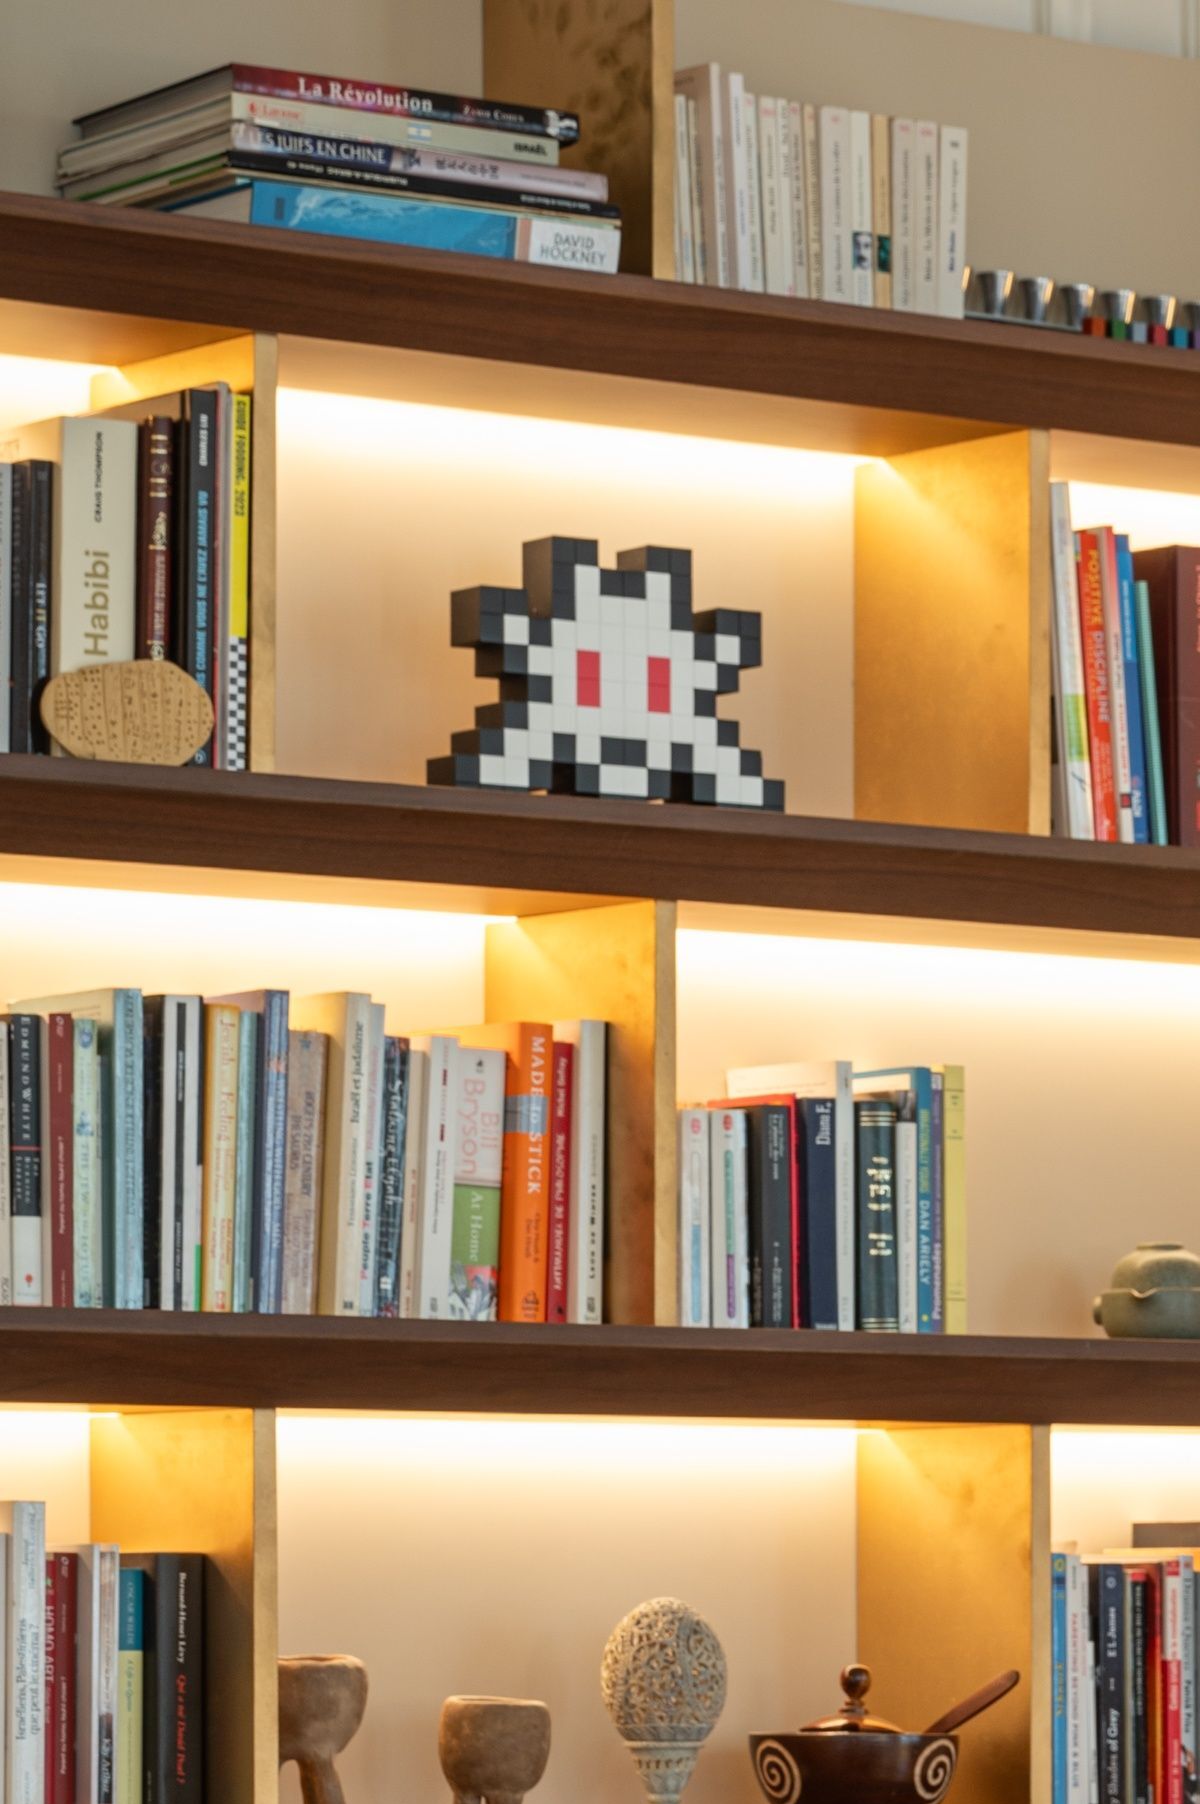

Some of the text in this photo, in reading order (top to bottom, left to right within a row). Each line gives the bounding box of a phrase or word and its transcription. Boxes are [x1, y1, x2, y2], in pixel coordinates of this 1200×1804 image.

[298, 77, 325, 96] La
[329, 81, 434, 114] Révolution
[316, 139, 339, 159] EN
[339, 141, 387, 165] CHINE
[540, 241, 608, 267] HOCKNEY
[554, 231, 596, 250] DAVID
[236, 399, 248, 432] GUIDE
[94, 431, 104, 524] CRAIG THOMPSON
[83, 549, 110, 657] Habibi
[1087, 549, 1110, 722] POSITIVE DISCIPLINE
[219, 1018, 236, 1066] Jewish
[20, 1016, 33, 1142] EDMUND WHITE
[349, 1021, 364, 1124] Israël et judaïsme
[216, 1090, 235, 1142] Feeling
[304, 1091, 316, 1130] ROGET'S
[457, 1078, 486, 1175] Bryson
[481, 1112, 500, 1148] Bill
[527, 1036, 546, 1195] MADE to STICK
[289, 1114, 302, 1170] THESAURUS
[380, 1079, 404, 1206] Stalking Elijah
[301, 1153, 313, 1197] CENTURY
[553, 1133, 566, 1202] PHILOSOPHIE
[271, 1223, 282, 1248] MEN
[361, 1193, 372, 1230] Terre
[468, 1191, 484, 1262] At Home
[553, 1203, 565, 1220] DE
[359, 1232, 371, 1281] Peuple
[919, 1199, 930, 1285] DAN ARIELY
[931, 1242, 942, 1321] Promenades
[45, 1605, 55, 1654] HOMO
[125, 1581, 135, 1646] OSCAR WILDE
[175, 1572, 187, 1664] Bernard-Henri Lévy
[1106, 1606, 1117, 1641] James
[1071, 1612, 1080, 1673] PARENTING
[16, 1618, 28, 1741] Israéliens, Palestiniens
[28, 1623, 41, 1736] que peut le cinéma ?
[45, 1657, 55, 1682] ART
[1071, 1676, 1080, 1720] BEYOND
[1106, 1707, 1120, 1738] Grey
[1183, 1679, 1192, 1733] Patrick Price
[1071, 1723, 1080, 1748] PINK
[1106, 1739, 1120, 1752] of
[100, 1737, 112, 1793] Kay Arthur
[1071, 1760, 1080, 1788] BLUE
[1106, 1754, 1120, 1796] Shades
